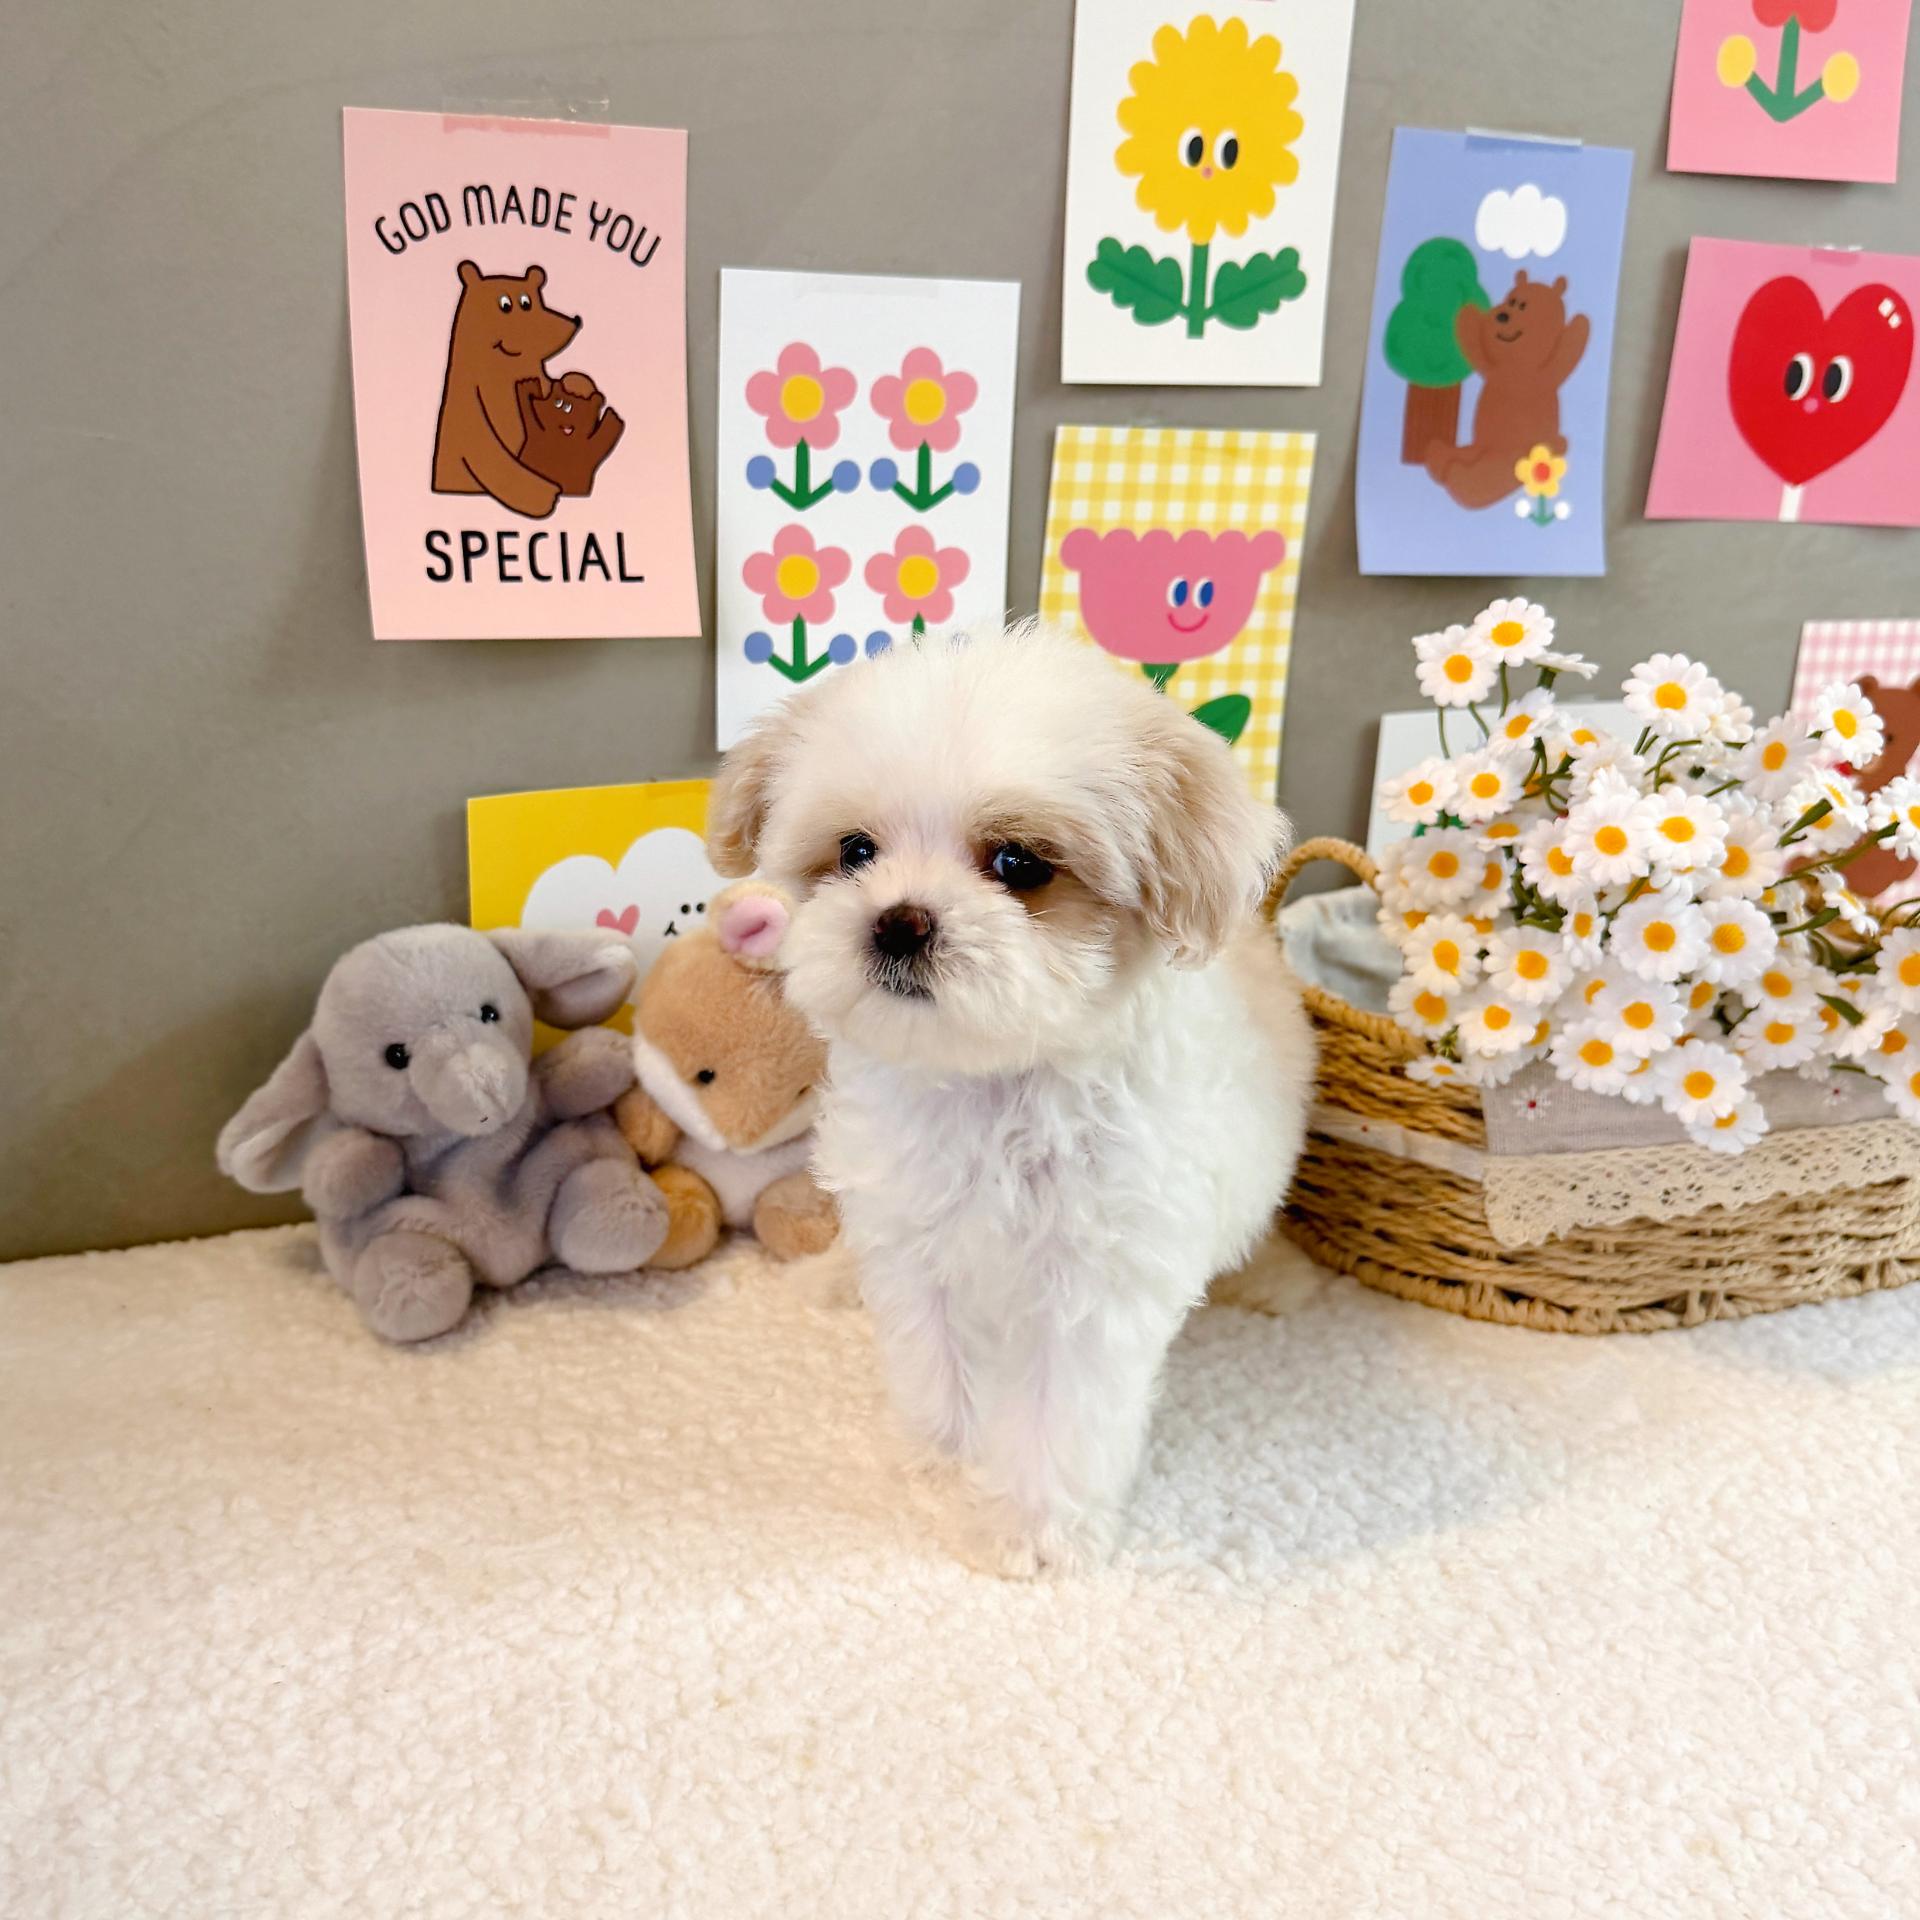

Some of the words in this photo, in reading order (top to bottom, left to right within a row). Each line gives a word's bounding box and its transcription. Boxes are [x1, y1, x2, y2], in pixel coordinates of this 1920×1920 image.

[374, 192, 452, 256] GOD
[463, 184, 578, 234] MADE
[589, 201, 662, 268] YOU
[425, 530, 645, 583] SPECIAL
